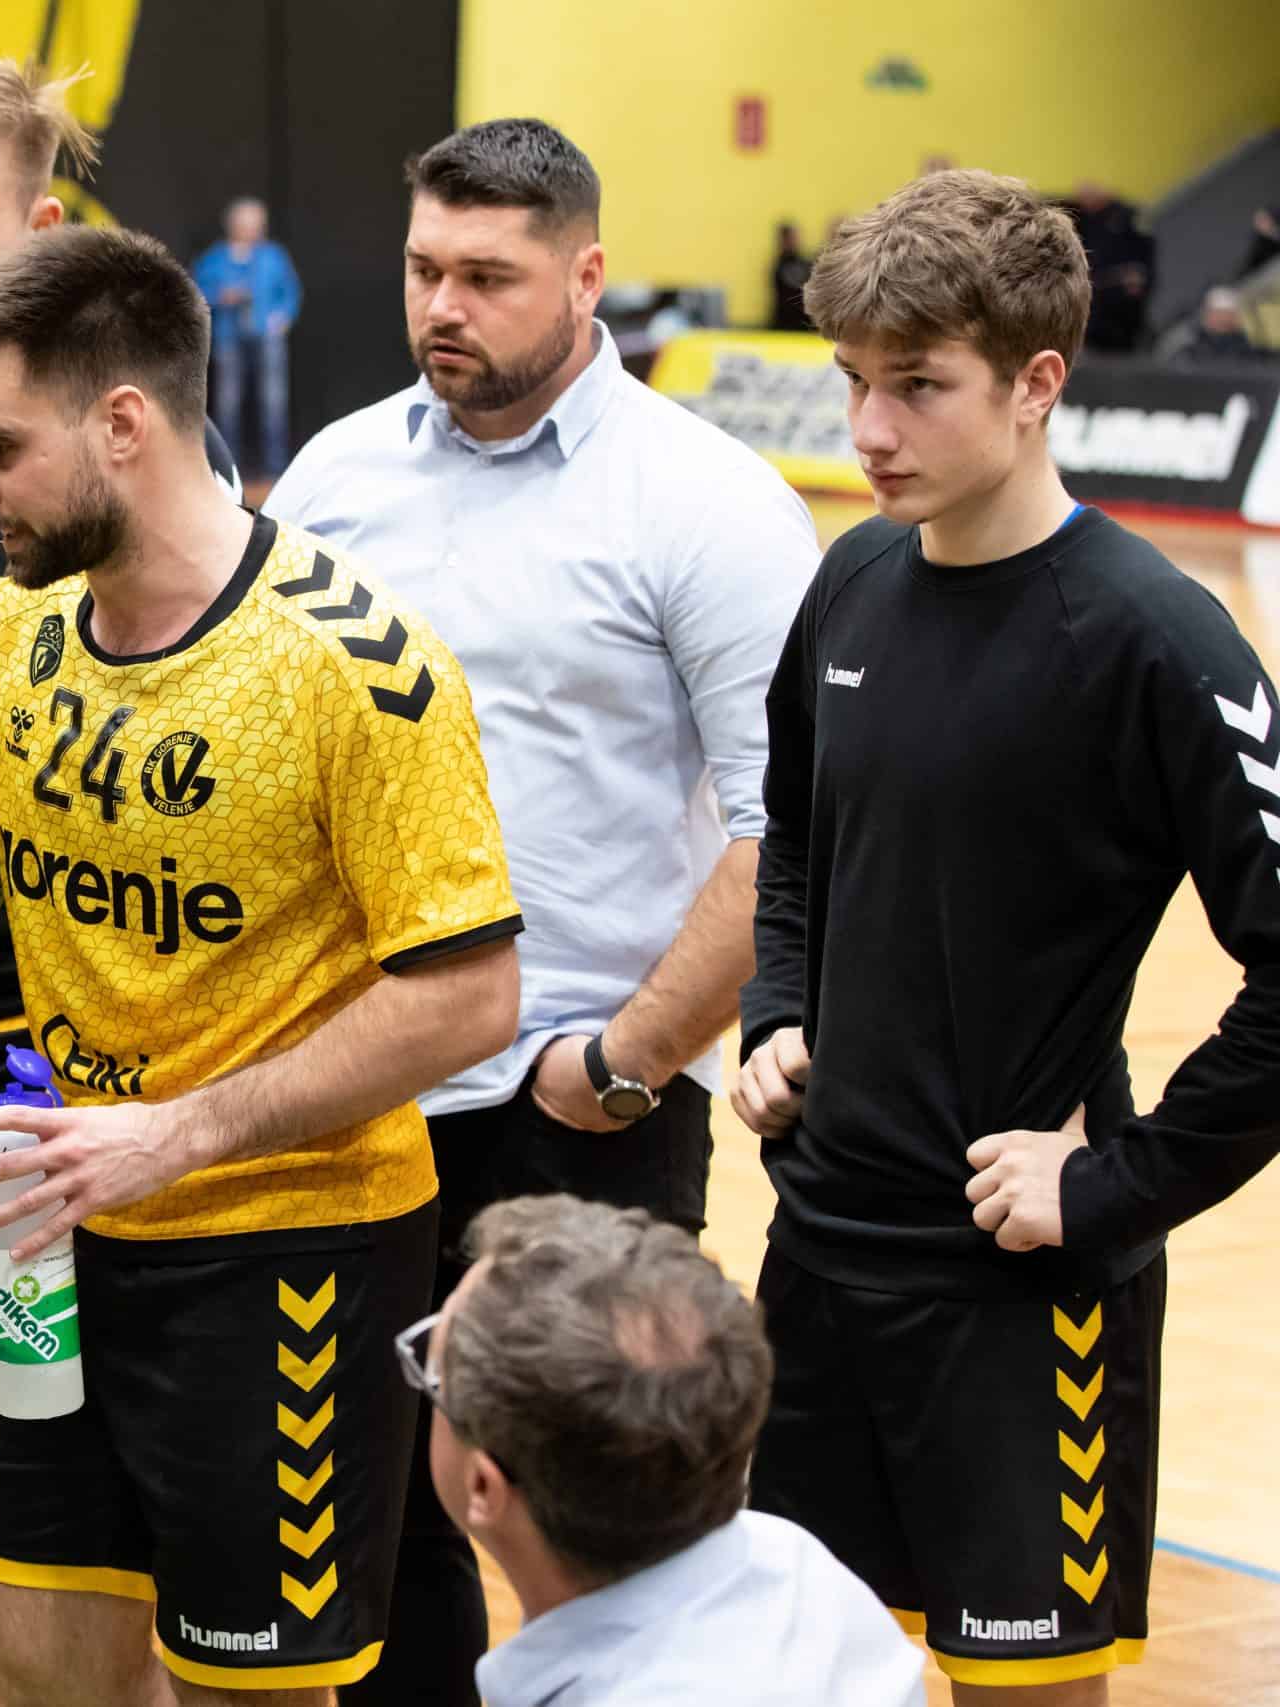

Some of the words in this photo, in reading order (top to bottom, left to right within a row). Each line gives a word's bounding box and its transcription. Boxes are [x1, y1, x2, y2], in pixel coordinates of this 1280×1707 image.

[33, 686, 137, 824] 24
[144, 757, 157, 774] RK
[153, 732, 195, 758] GORENJE
[153, 796, 196, 816] VELENJE
[179, 1614, 278, 1651] hummel
[960, 1608, 1060, 1641] hummel
